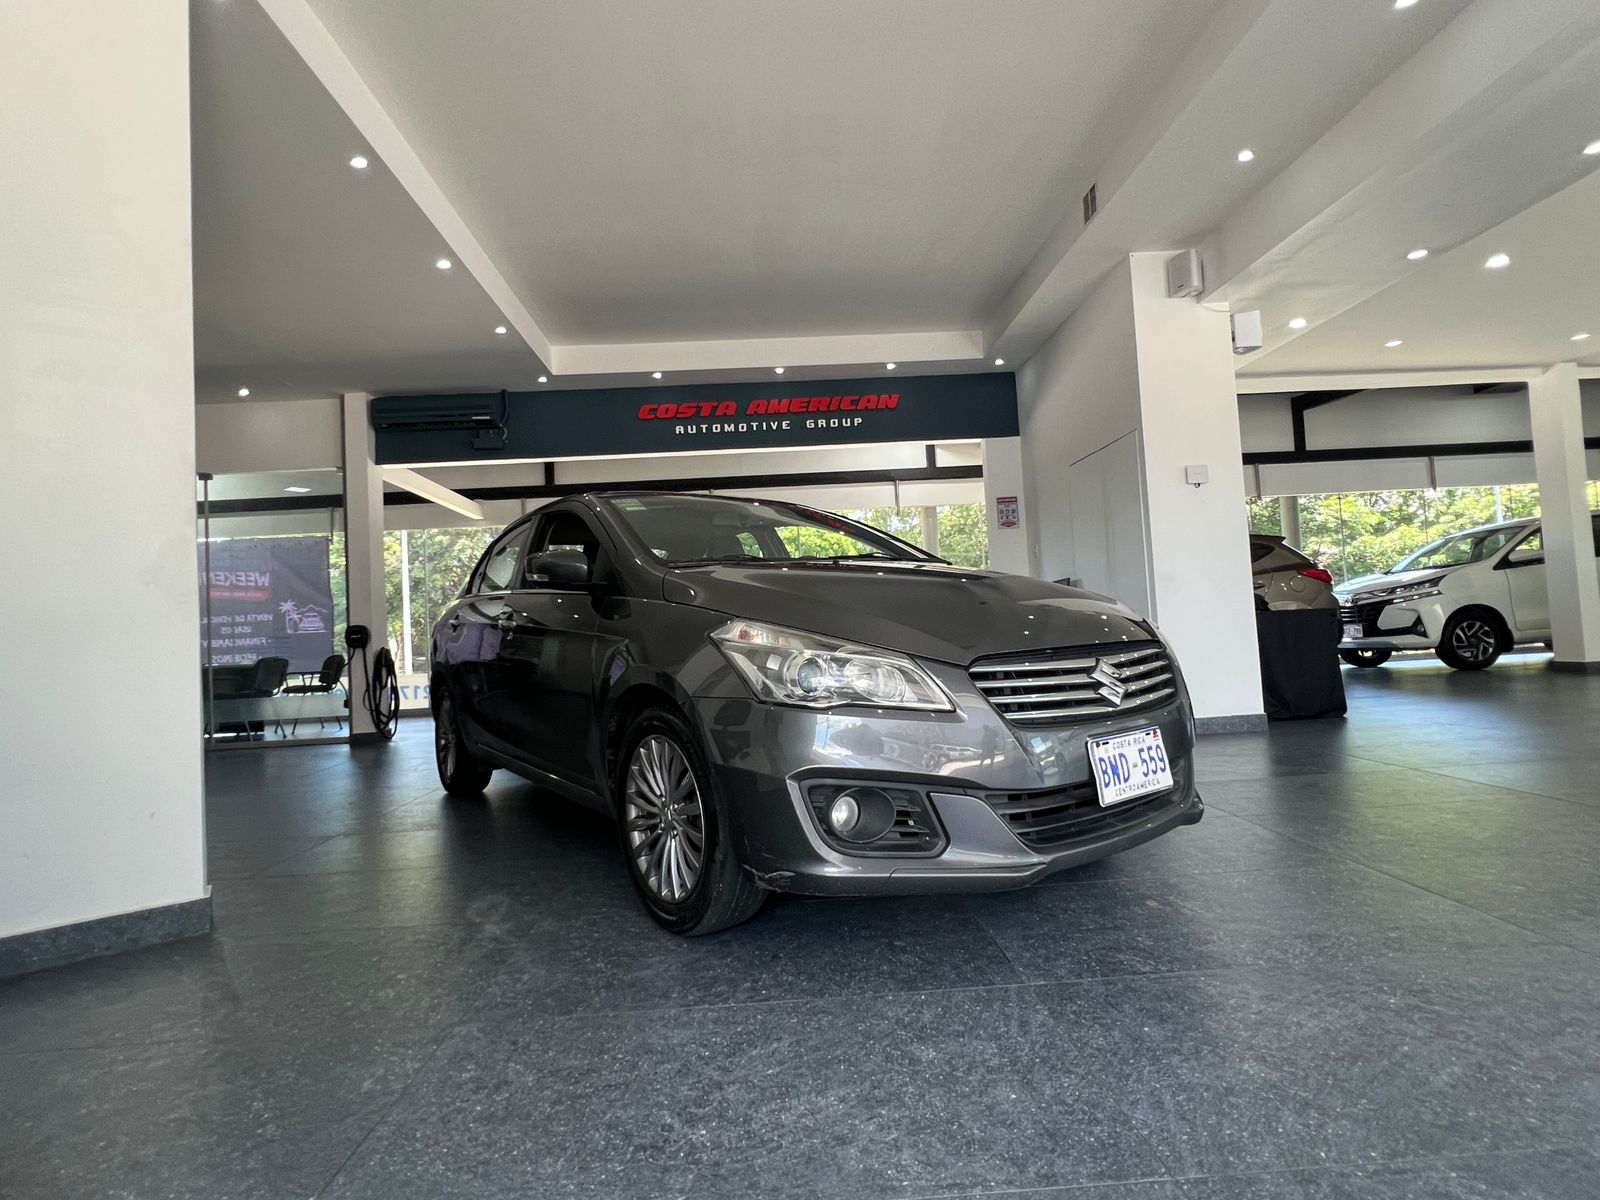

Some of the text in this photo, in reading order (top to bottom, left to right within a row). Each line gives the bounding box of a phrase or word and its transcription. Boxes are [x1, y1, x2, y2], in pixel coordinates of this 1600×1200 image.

[638, 394, 900, 420] COSTA AMERICAN
[675, 417, 864, 435] AUTOMOTIVE GROUP
[1112, 738, 1132, 750] COSTA
[1098, 743, 1167, 789] BND-559
[1114, 778, 1161, 797] CENTROAMERICA
